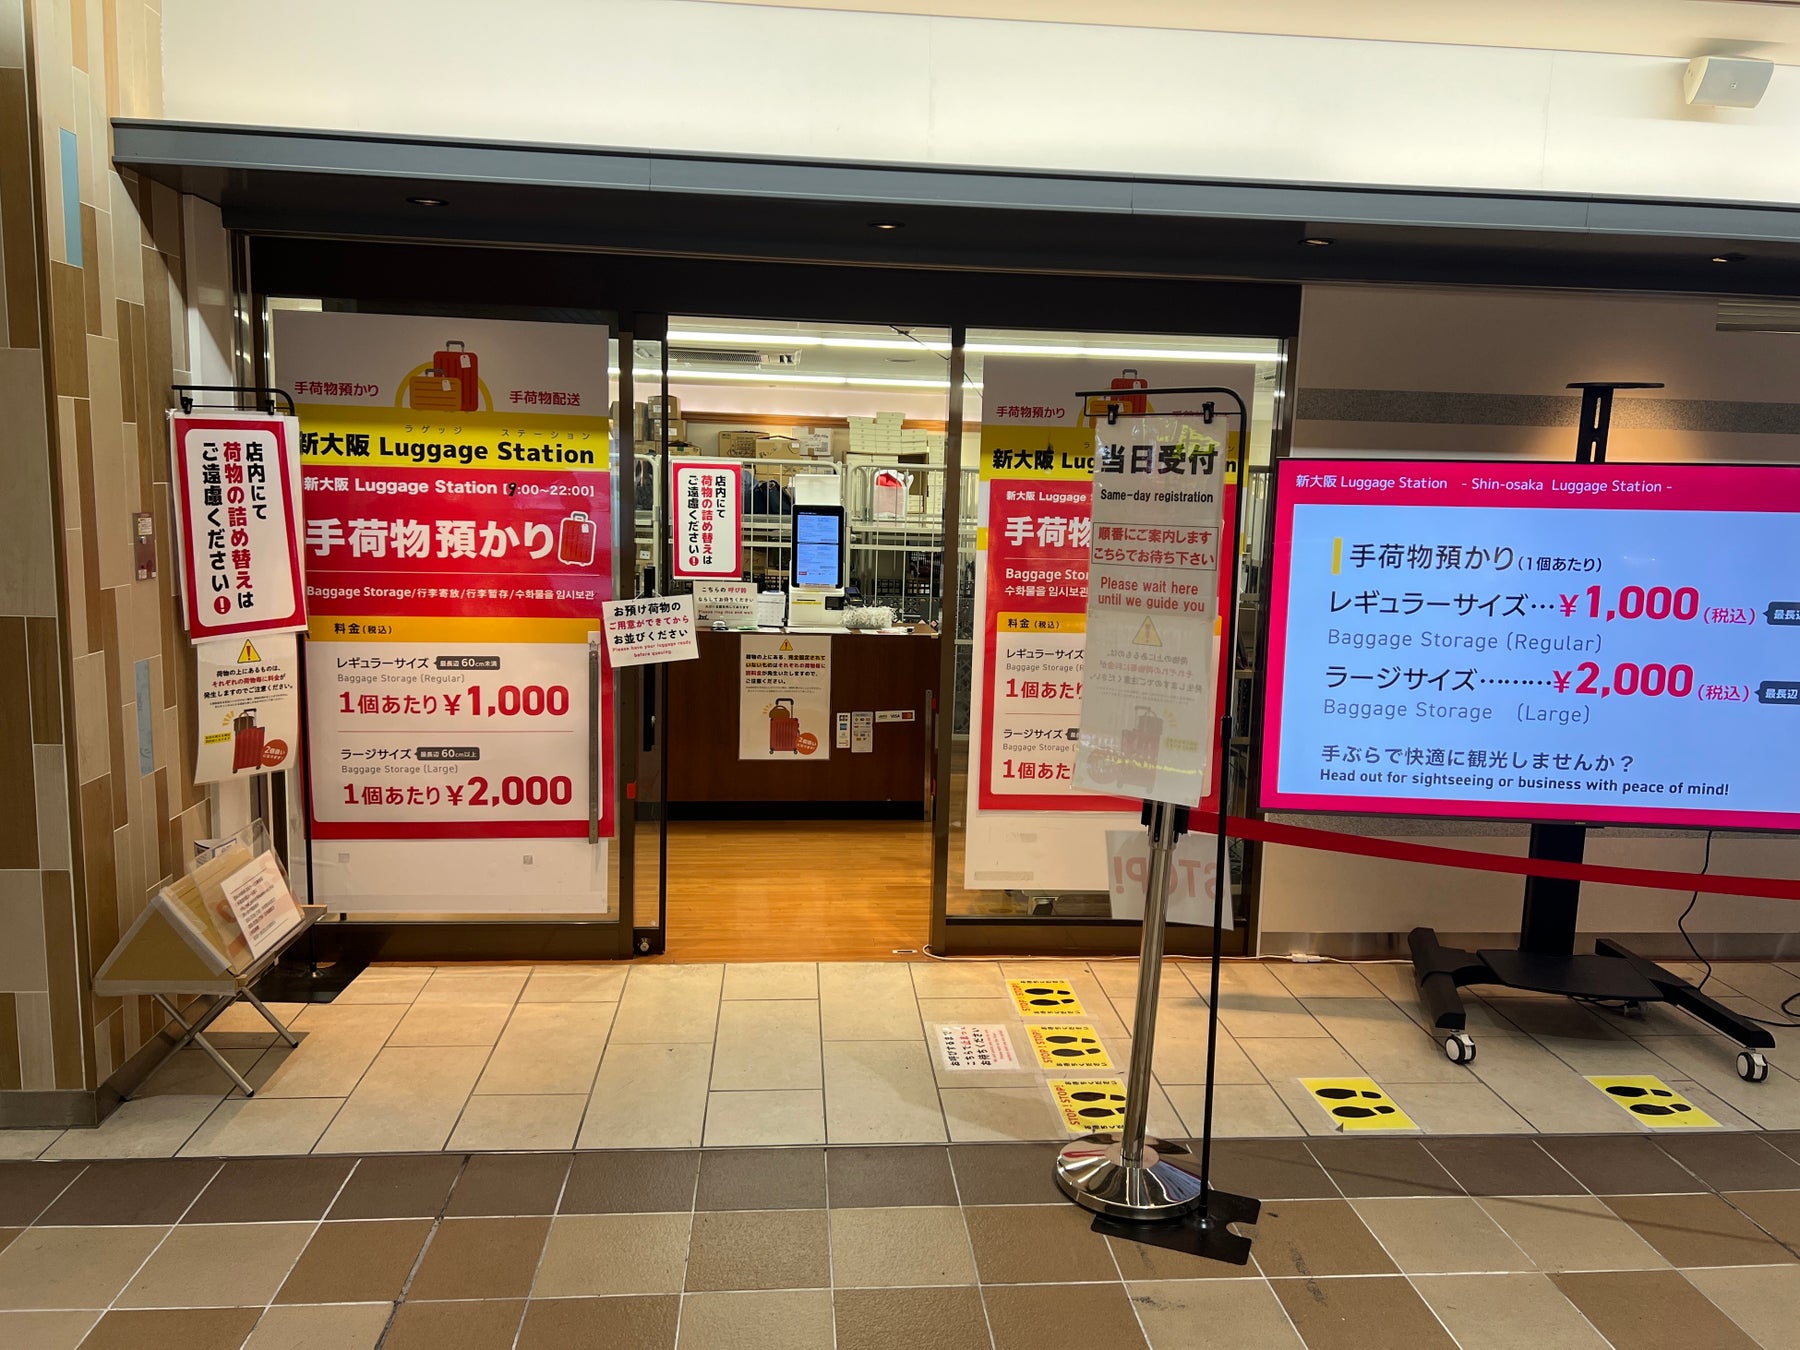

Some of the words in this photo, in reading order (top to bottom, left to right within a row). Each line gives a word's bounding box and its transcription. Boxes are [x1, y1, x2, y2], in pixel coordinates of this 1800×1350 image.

[294, 380, 380, 398] 手荷物預かり
[509, 390, 581, 407] 手荷物配送
[996, 406, 1066, 419] 手荷物預かり
[300, 431, 370, 457] 新大阪
[380, 436, 489, 464] Luggage
[497, 441, 595, 465] Station
[993, 448, 1054, 470] 新大阪
[1100, 444, 1218, 475] 当日受付
[246, 441, 268, 520] 店内にて
[304, 476, 350, 493] 新大阪
[354, 477, 430, 496] Luggage
[435, 479, 498, 495] Station
[1295, 474, 1337, 488] 新大阪
[1341, 475, 1395, 490] Luggage
[1399, 476, 1448, 489] Station
[1471, 477, 1544, 490] Shin-osaka
[1551, 479, 1608, 494] Luggage
[1612, 480, 1662, 493] Station
[715, 475, 726, 519] 店内にて
[1006, 491, 1036, 502] 新大阪
[1039, 491, 1087, 504] Luggage
[1100, 489, 1151, 503] Same-day
[1154, 490, 1214, 504] registration
[223, 441, 255, 609] 荷物の詰め替えは
[701, 475, 714, 565] 荷物の詰め替えは
[304, 518, 554, 561] 手荷物預かり
[1098, 526, 1213, 546] 順番にご案内します
[1093, 547, 1215, 567] こちらでお待ち下さい
[1005, 568, 1062, 582] Baggage
[306, 585, 361, 600] Baggage
[1100, 576, 1138, 592] Please
[1142, 580, 1167, 593] wait
[1172, 581, 1198, 596] here
[614, 602, 681, 617] お預け荷物の
[1098, 592, 1122, 606] until
[1125, 596, 1142, 608] we
[1146, 595, 1179, 611] guide
[1182, 600, 1205, 613] you
[609, 615, 689, 631] ご用意ができてから
[614, 629, 688, 645] お並びください
[1328, 628, 1413, 650] Baggage
[1420, 631, 1498, 652] Storage
[1507, 632, 1602, 654] (Regular)
[337, 656, 430, 670] レギュラーサイズ
[1006, 648, 1085, 660] レギュラーサイズ
[1006, 662, 1040, 673] Baggage
[1042, 663, 1073, 673] Storage
[337, 673, 378, 684] Baggage
[380, 674, 418, 684] Storage
[420, 673, 465, 685] (Regular)
[339, 691, 438, 715] 1個あたり
[443, 684, 570, 718] ¥1,000
[1324, 698, 1408, 720] Baggage
[1415, 701, 1493, 723] Storage
[1516, 702, 1591, 726] (Large)
[1003, 728, 1063, 740] ラージサイズ
[340, 748, 412, 761] ラージサイズ
[1002, 743, 1037, 752] Baggage
[1039, 743, 1072, 753] Storage
[341, 764, 382, 775] Baggage
[384, 764, 421, 775] Storage
[423, 764, 459, 775] (Large)
[343, 783, 441, 806] 1個あたり
[445, 775, 572, 808] ¥2,000
[1320, 768, 1356, 782] Head
[1360, 771, 1383, 783] out
[1387, 771, 1408, 784] for
[1412, 772, 1494, 789] sightseeing
[1498, 777, 1514, 787] or
[1518, 776, 1581, 790] business
[1586, 778, 1618, 791] with
[1622, 783, 1665, 795] peace
[1668, 782, 1683, 794] of
[1687, 783, 1729, 796] mind!
